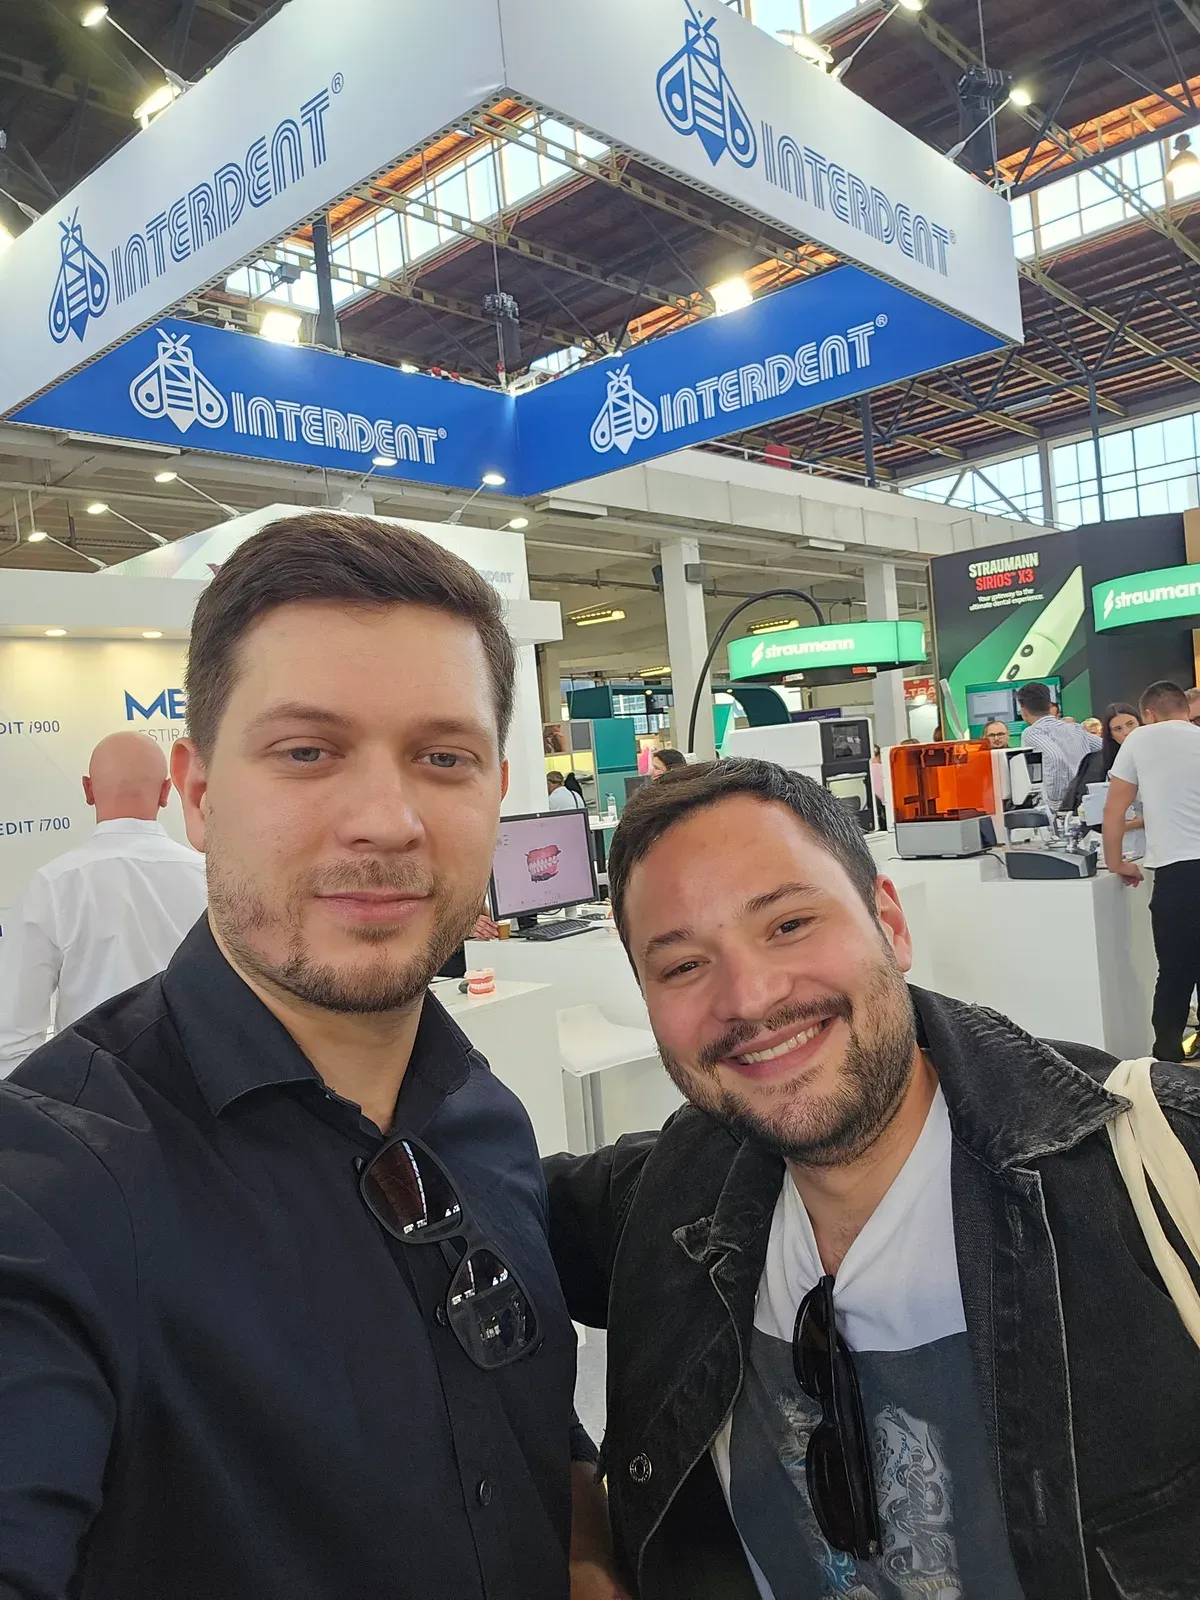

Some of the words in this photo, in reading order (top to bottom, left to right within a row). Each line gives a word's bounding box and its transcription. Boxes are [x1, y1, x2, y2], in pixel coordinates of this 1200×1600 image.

[968, 552, 1039, 578] STRAUMANN
[1017, 568, 1035, 584] X3
[764, 638, 855, 660] straumann
[29, 720, 61, 734] i900
[39, 817, 71, 832] i700
